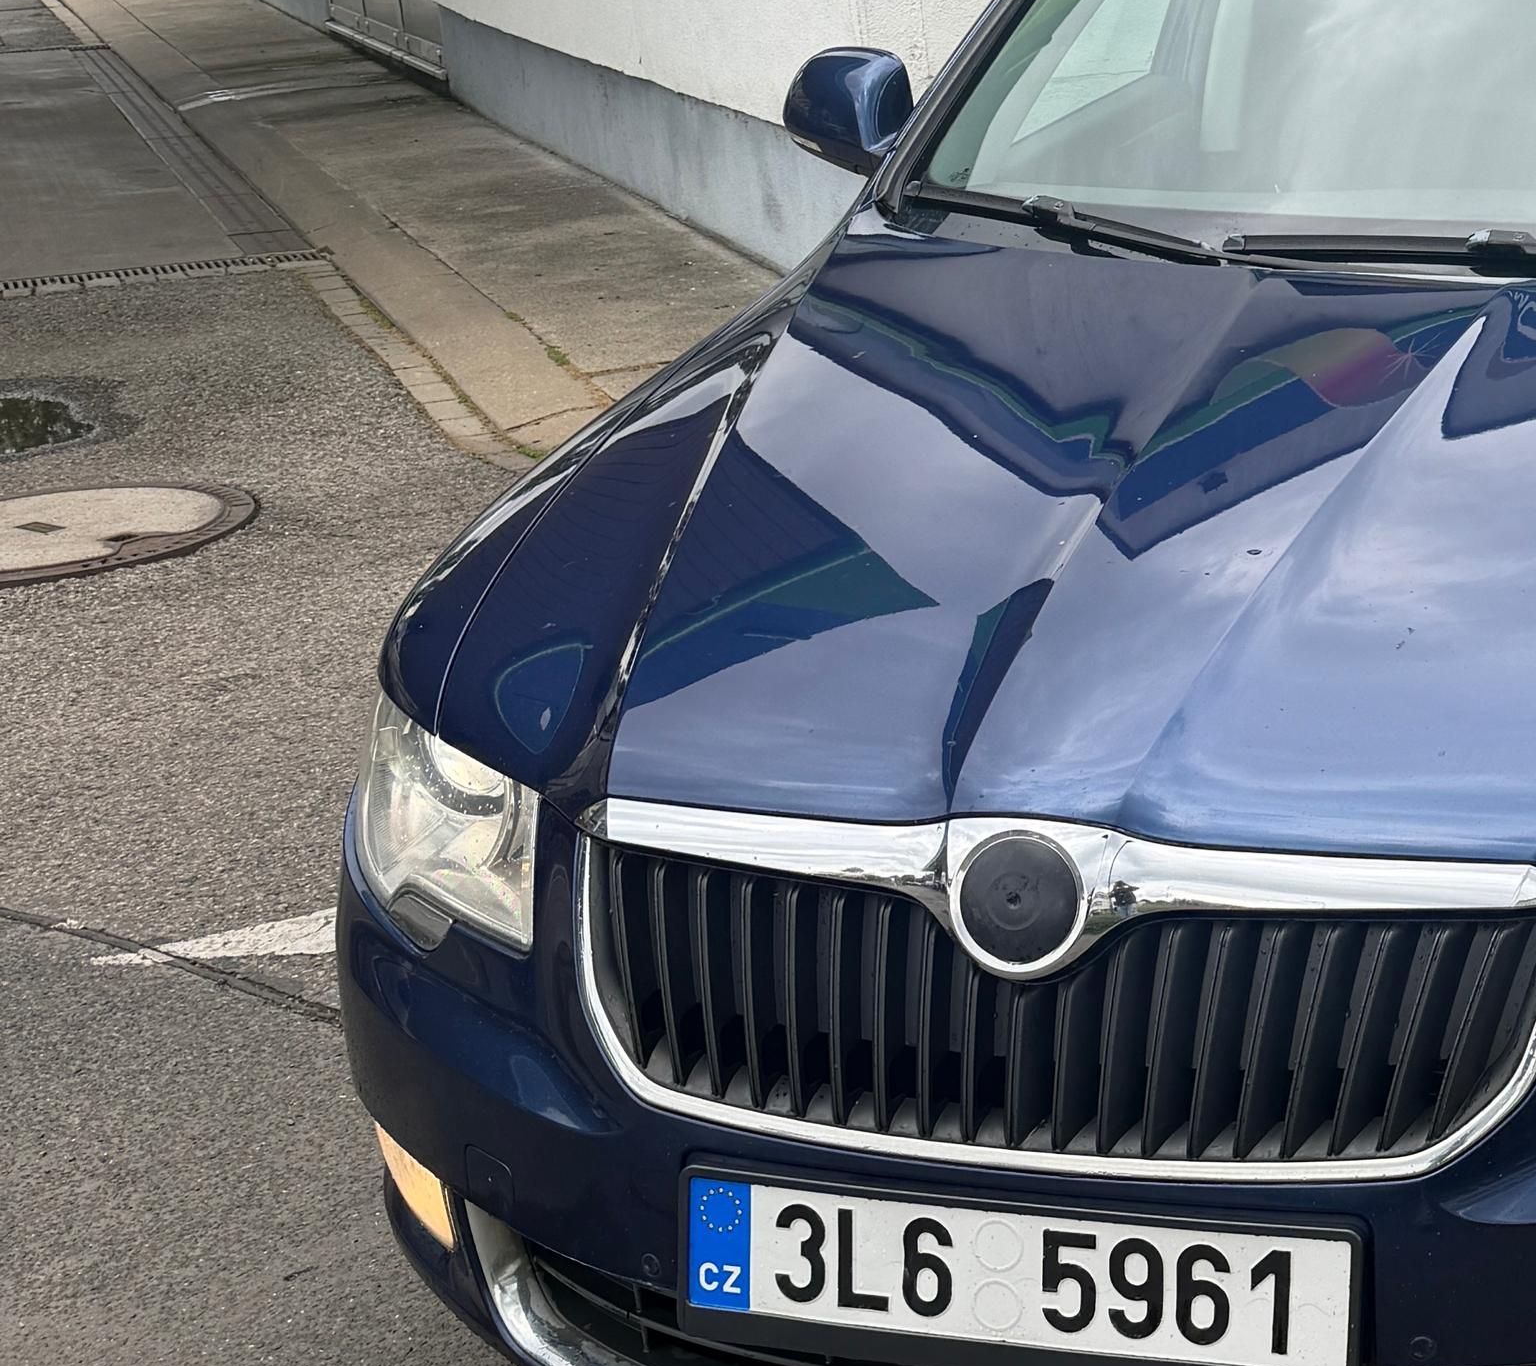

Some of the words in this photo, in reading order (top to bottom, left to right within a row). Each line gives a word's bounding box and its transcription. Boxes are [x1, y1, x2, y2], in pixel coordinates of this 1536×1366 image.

[698, 1260, 742, 1295] CZ
[774, 1202, 954, 1318] 3L6
[1041, 1228, 1292, 1356] 5961
